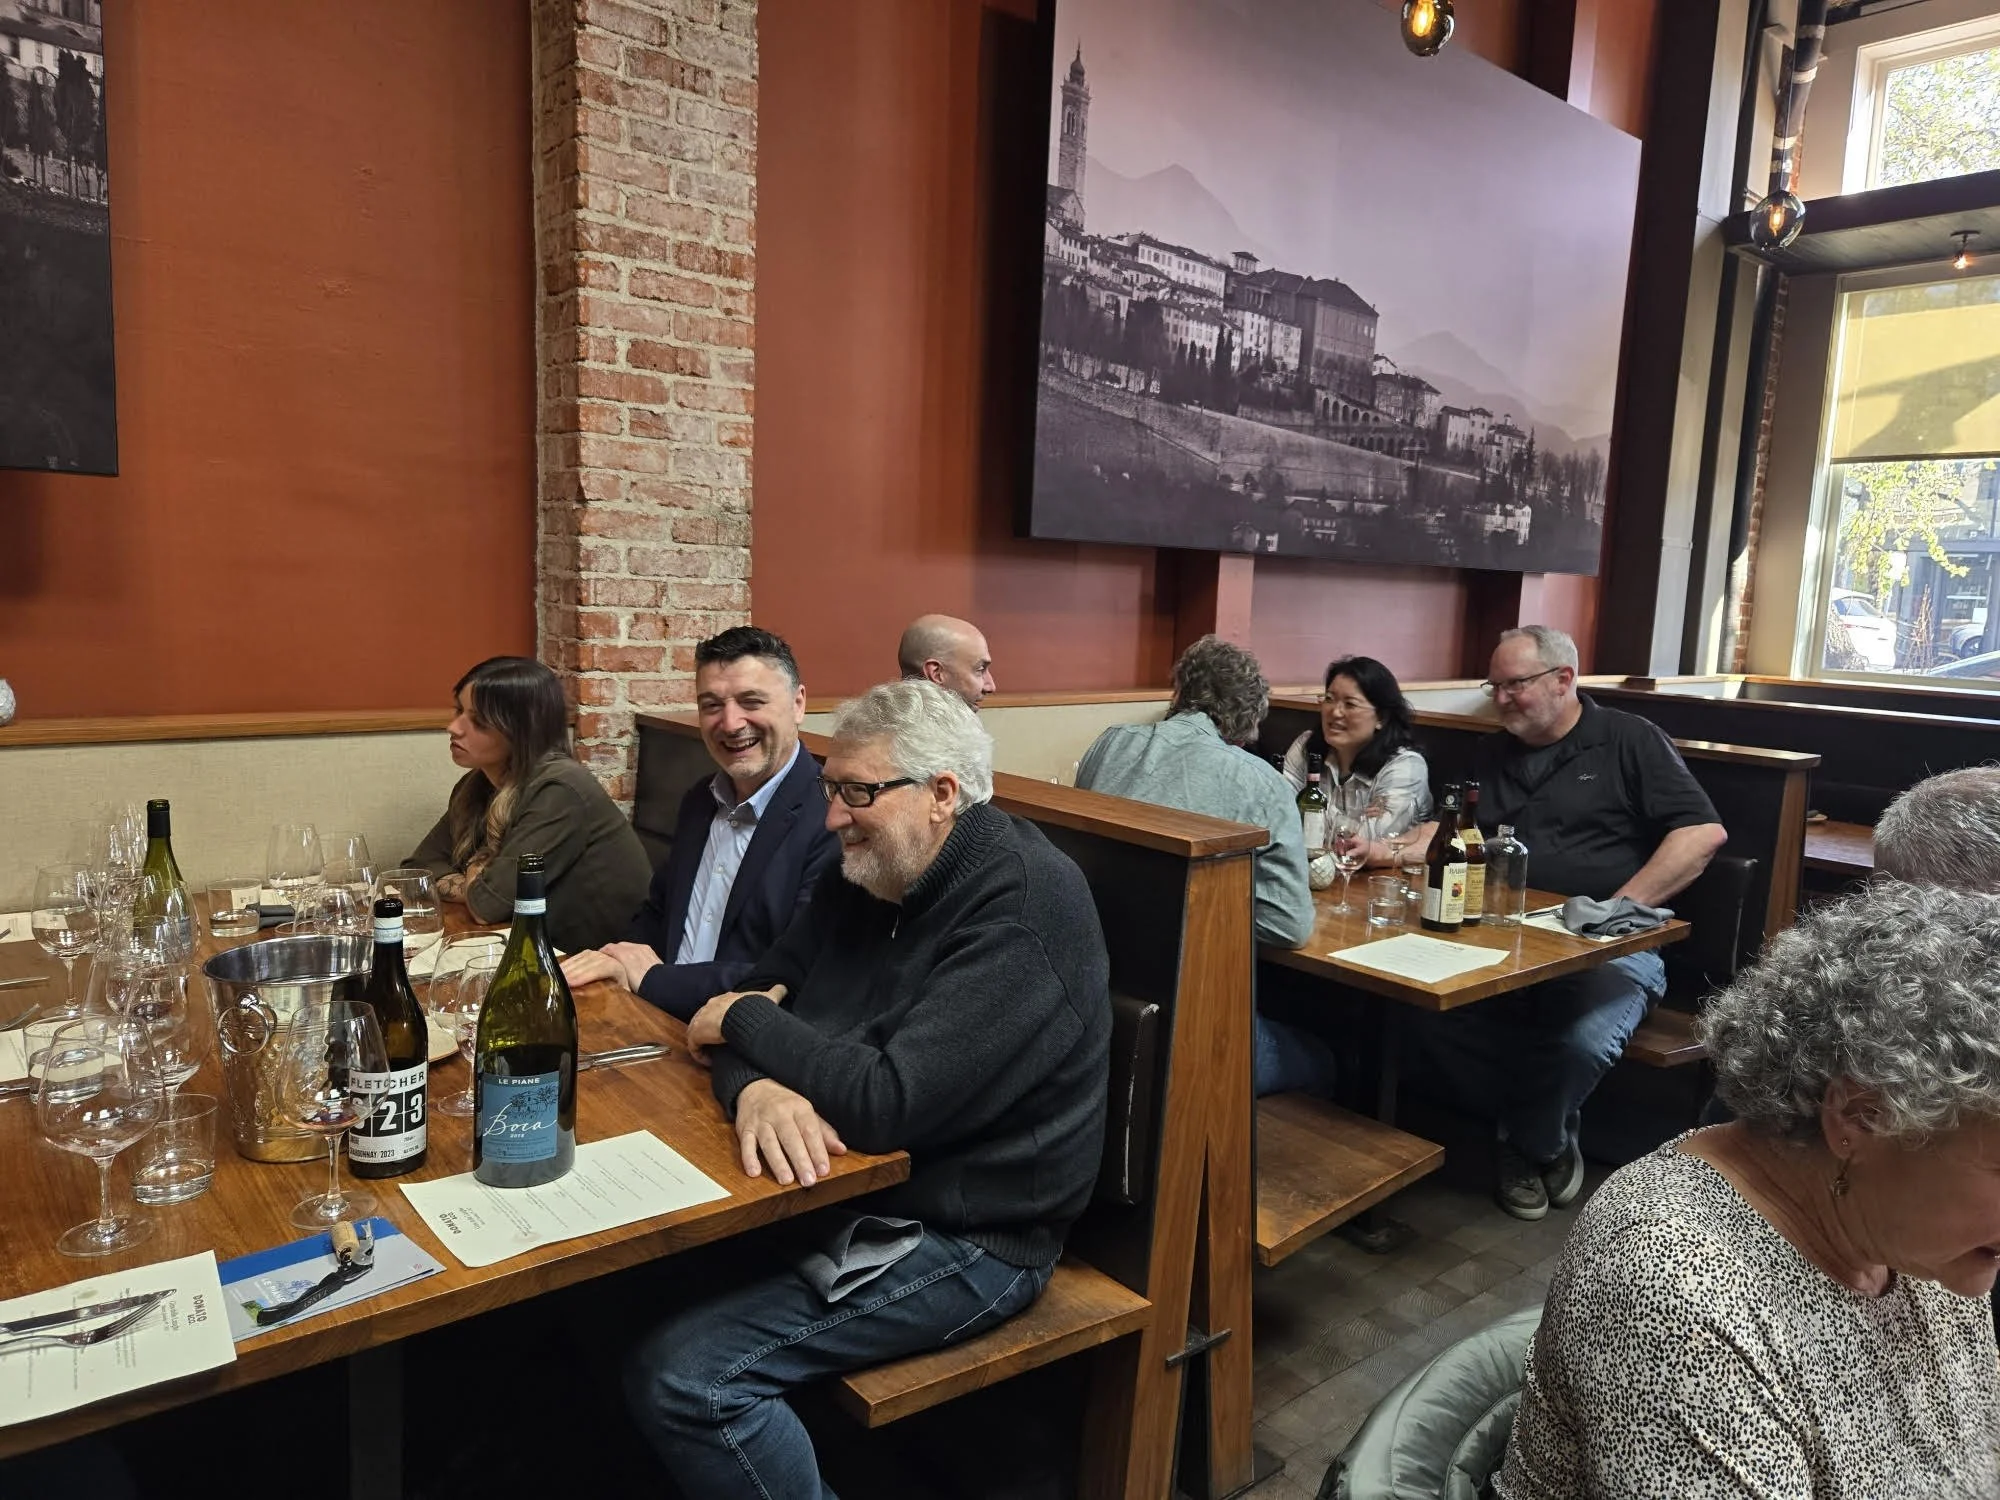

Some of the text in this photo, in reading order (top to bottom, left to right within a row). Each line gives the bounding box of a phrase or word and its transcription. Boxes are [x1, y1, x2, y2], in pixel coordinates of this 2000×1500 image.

[350, 1071, 425, 1089] FLETCHER
[511, 1077, 541, 1085] PIANE
[380, 1149, 395, 1159] 2023
[192, 1294, 208, 1323] DONATO
